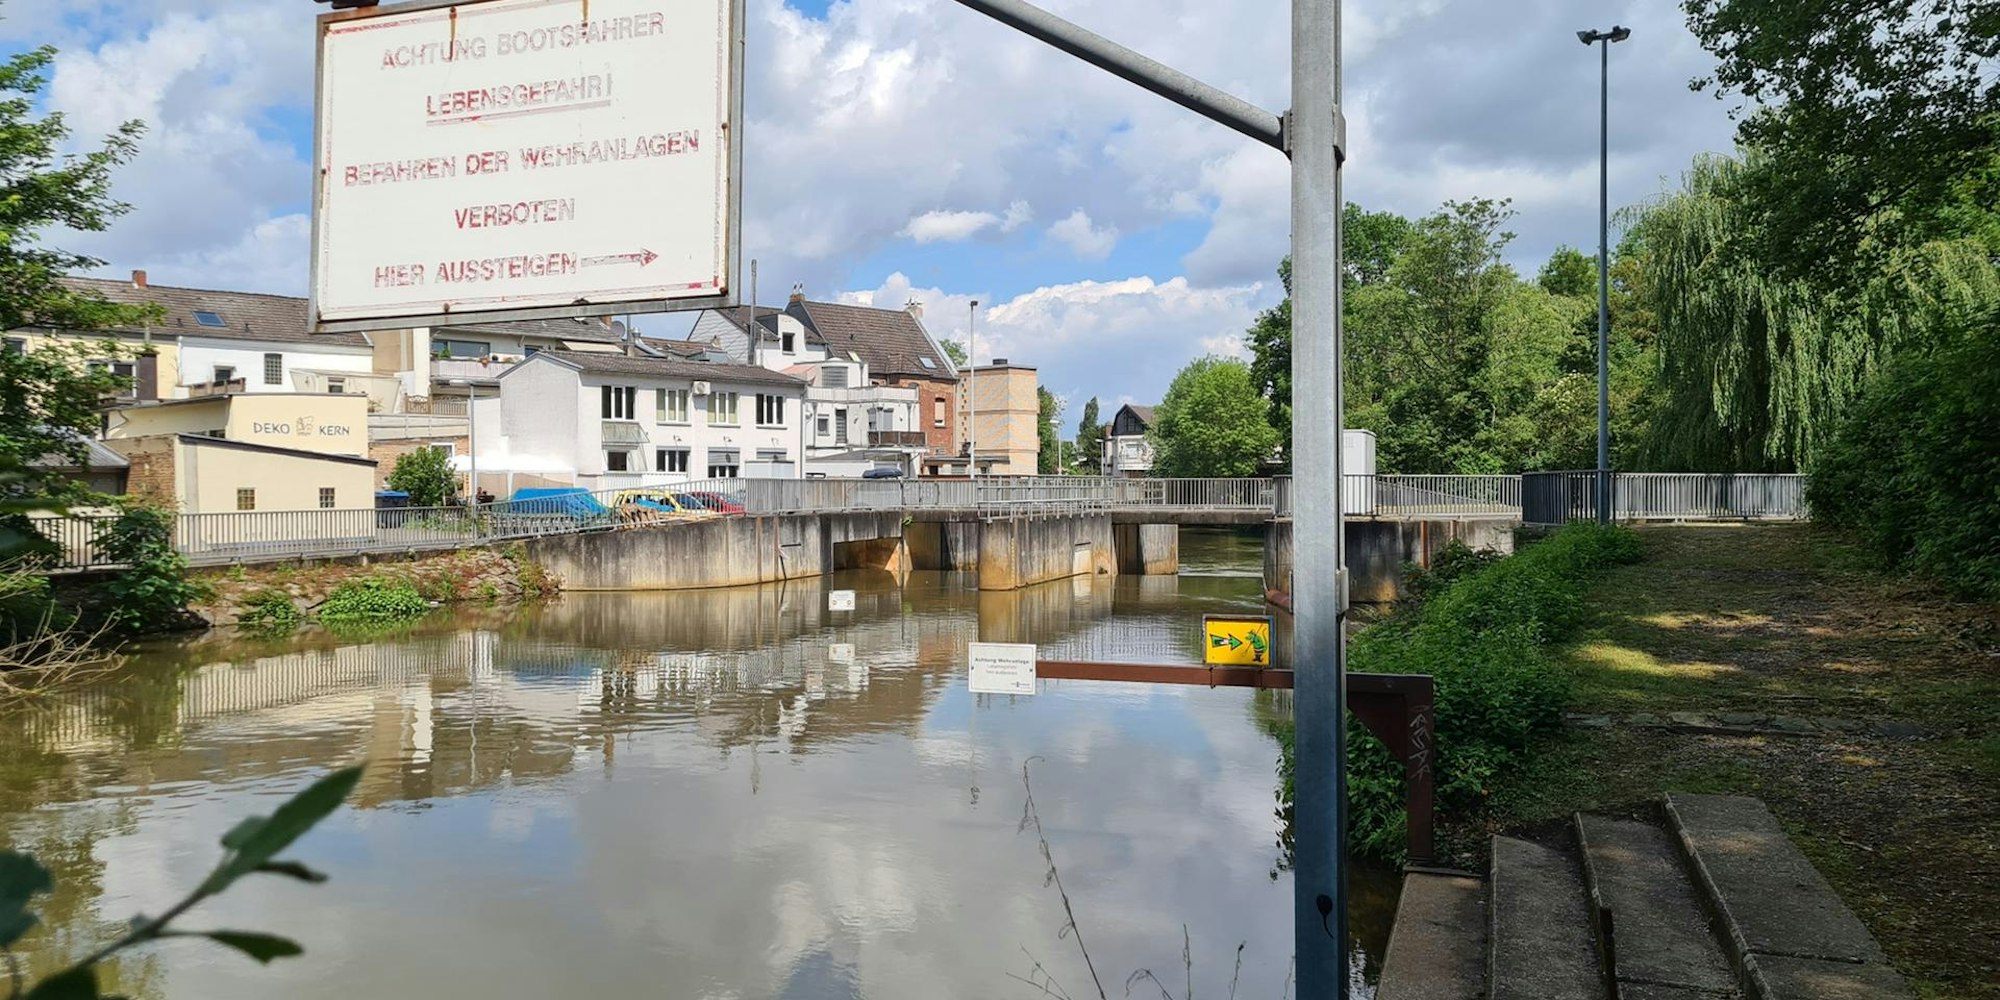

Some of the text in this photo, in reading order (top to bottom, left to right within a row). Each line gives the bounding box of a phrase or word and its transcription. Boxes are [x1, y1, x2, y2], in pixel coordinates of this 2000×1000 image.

[380, 11, 666, 71] ACHTUNG BOOTSFAHRER
[343, 129, 700, 187] BEFAHREN DER WEHRANLAGEN
[454, 198, 576, 230] VERBOTEN
[374, 252, 578, 288] HIER AUSSTEIGEN
[253, 422, 350, 436] DEKO KERN
